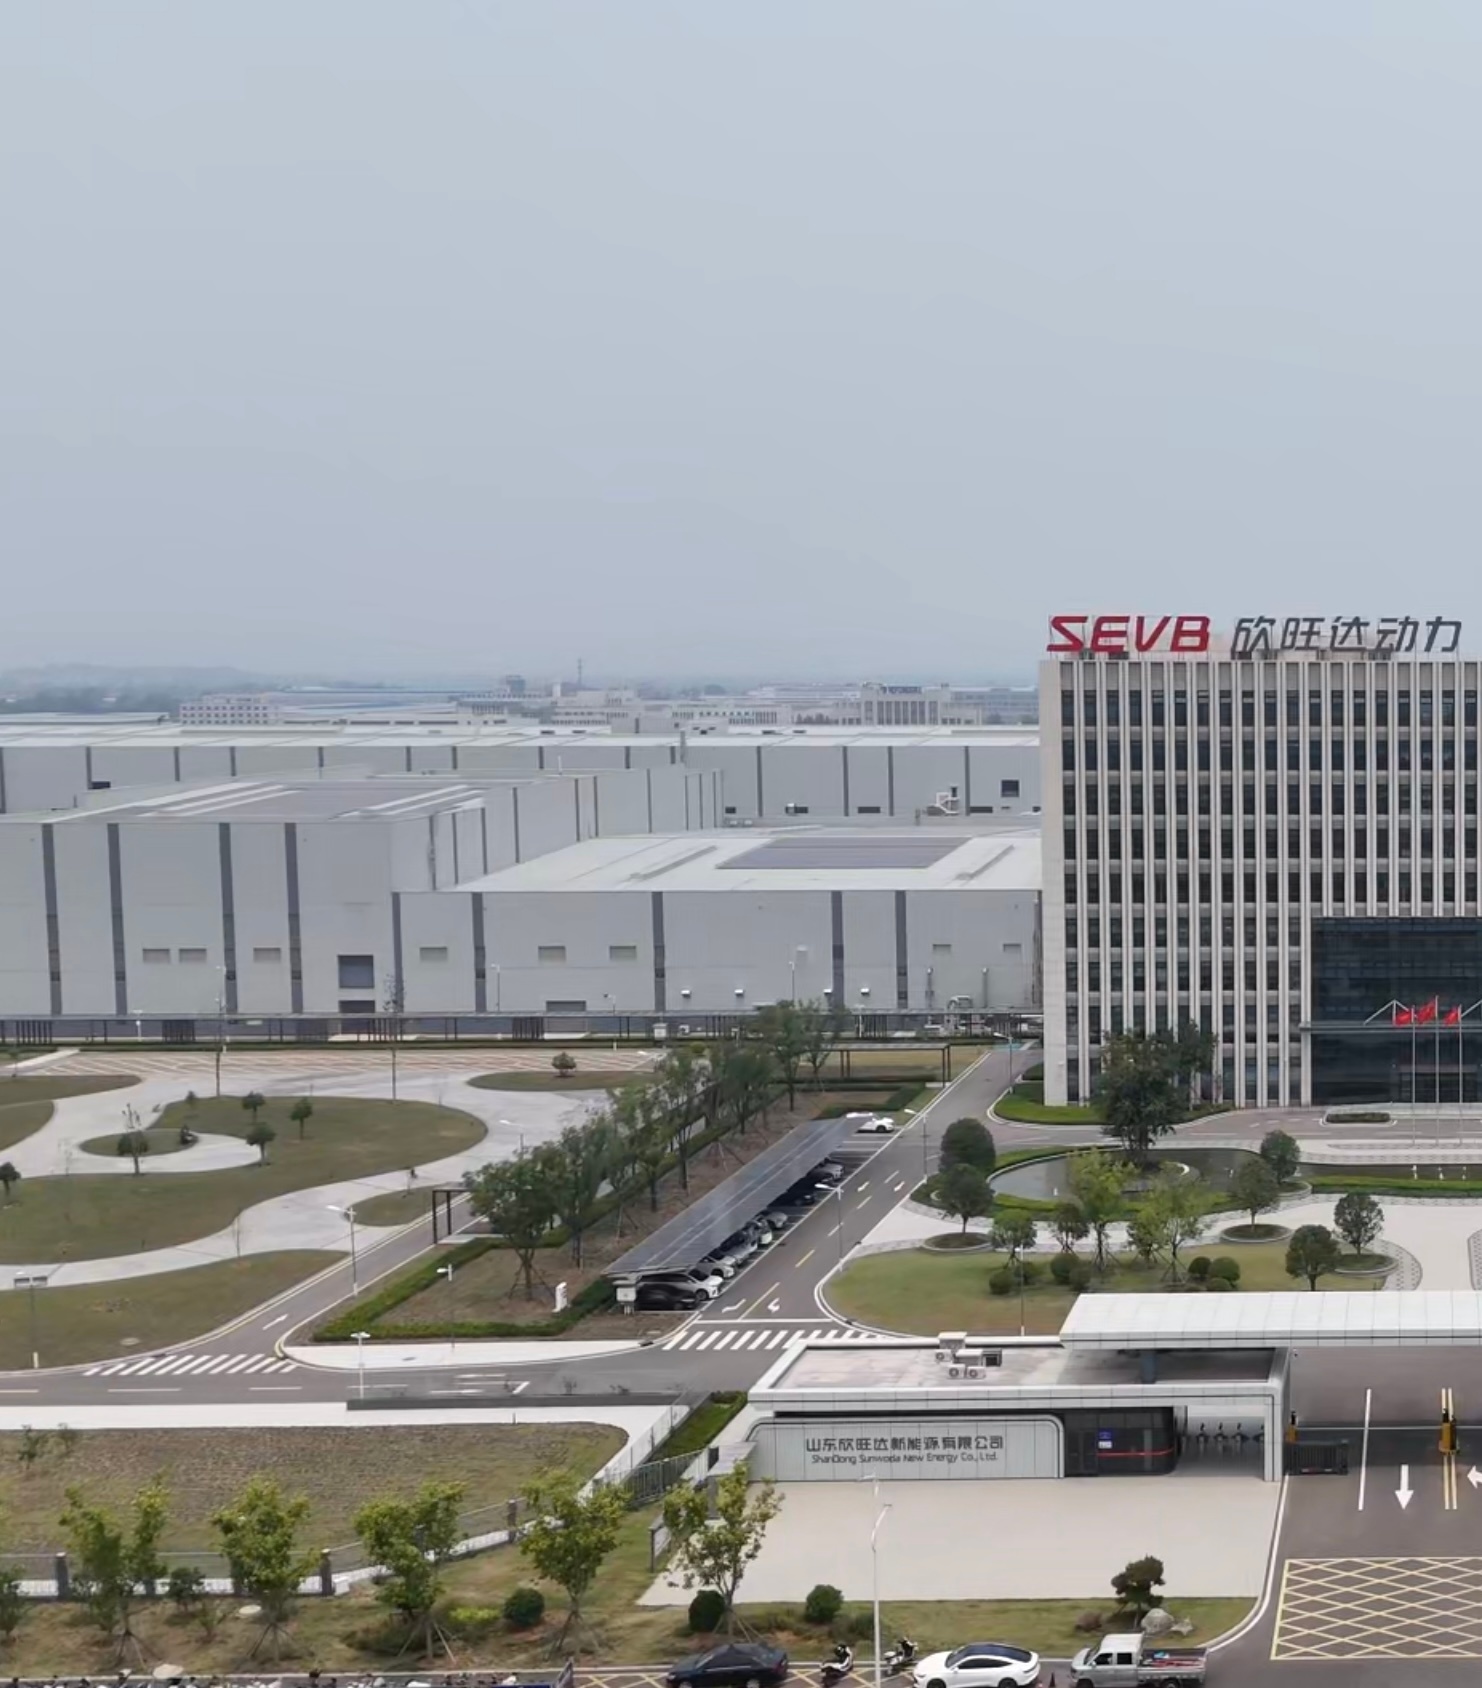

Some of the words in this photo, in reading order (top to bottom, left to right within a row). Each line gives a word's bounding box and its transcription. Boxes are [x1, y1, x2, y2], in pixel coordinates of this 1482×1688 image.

[1047, 616, 1210, 653] SEVB
[1231, 616, 1462, 653] 欣旺达动力
[806, 1436, 1004, 1452] 山东欣旺达新能源有限公司
[903, 1453, 924, 1462] New
[926, 1453, 958, 1463] Energy
